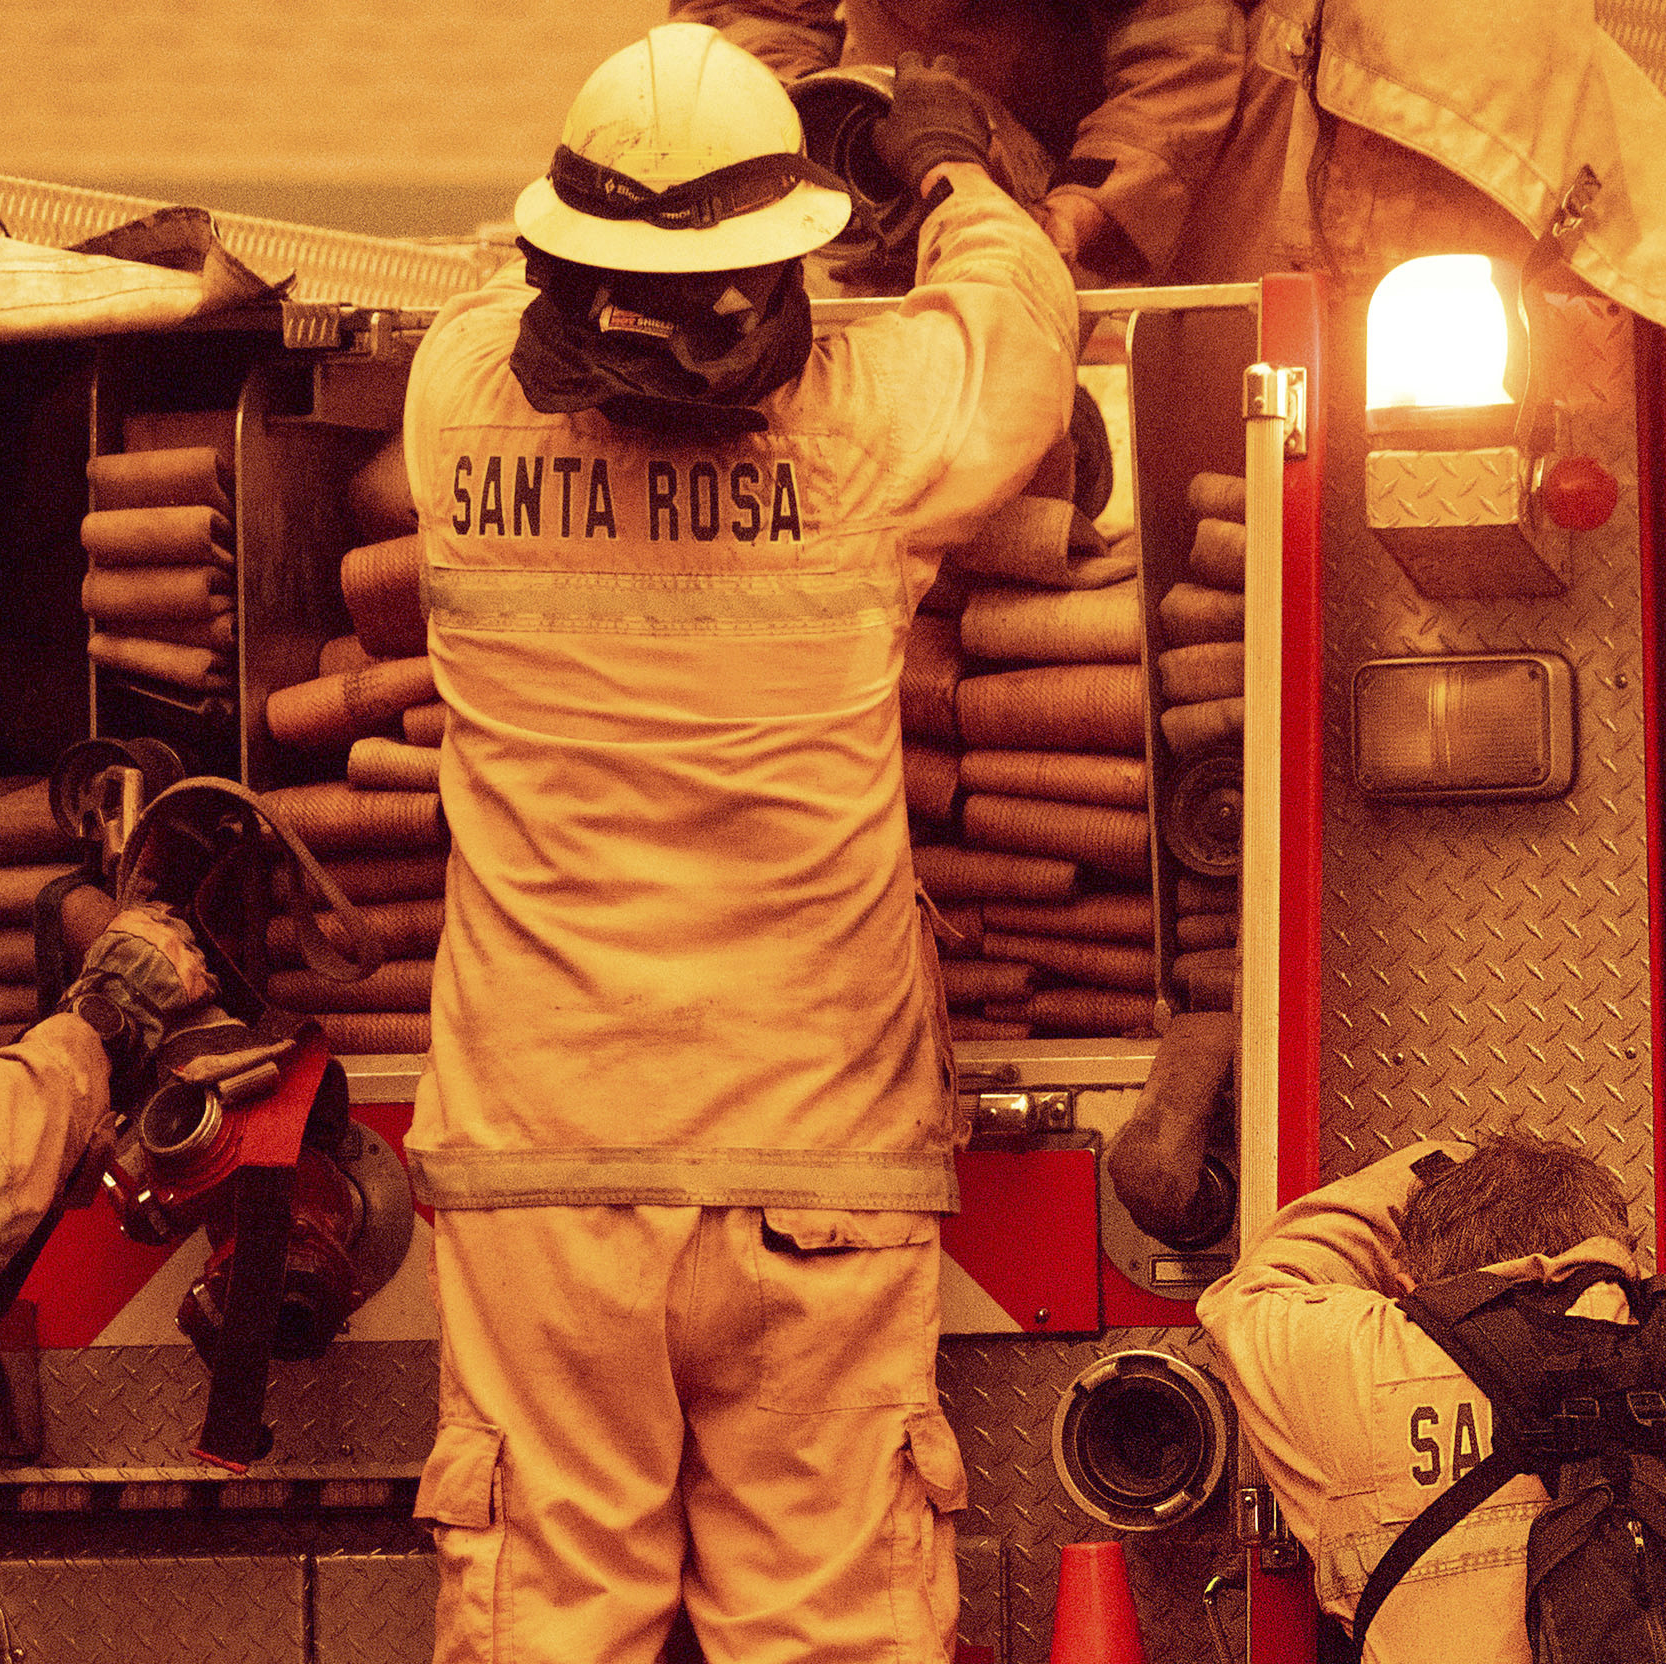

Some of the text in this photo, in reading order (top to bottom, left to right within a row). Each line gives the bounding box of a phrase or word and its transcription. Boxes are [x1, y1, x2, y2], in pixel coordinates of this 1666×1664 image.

[617, 183, 645, 202] Blac
[451, 455, 804, 543] SANTA ROSA
